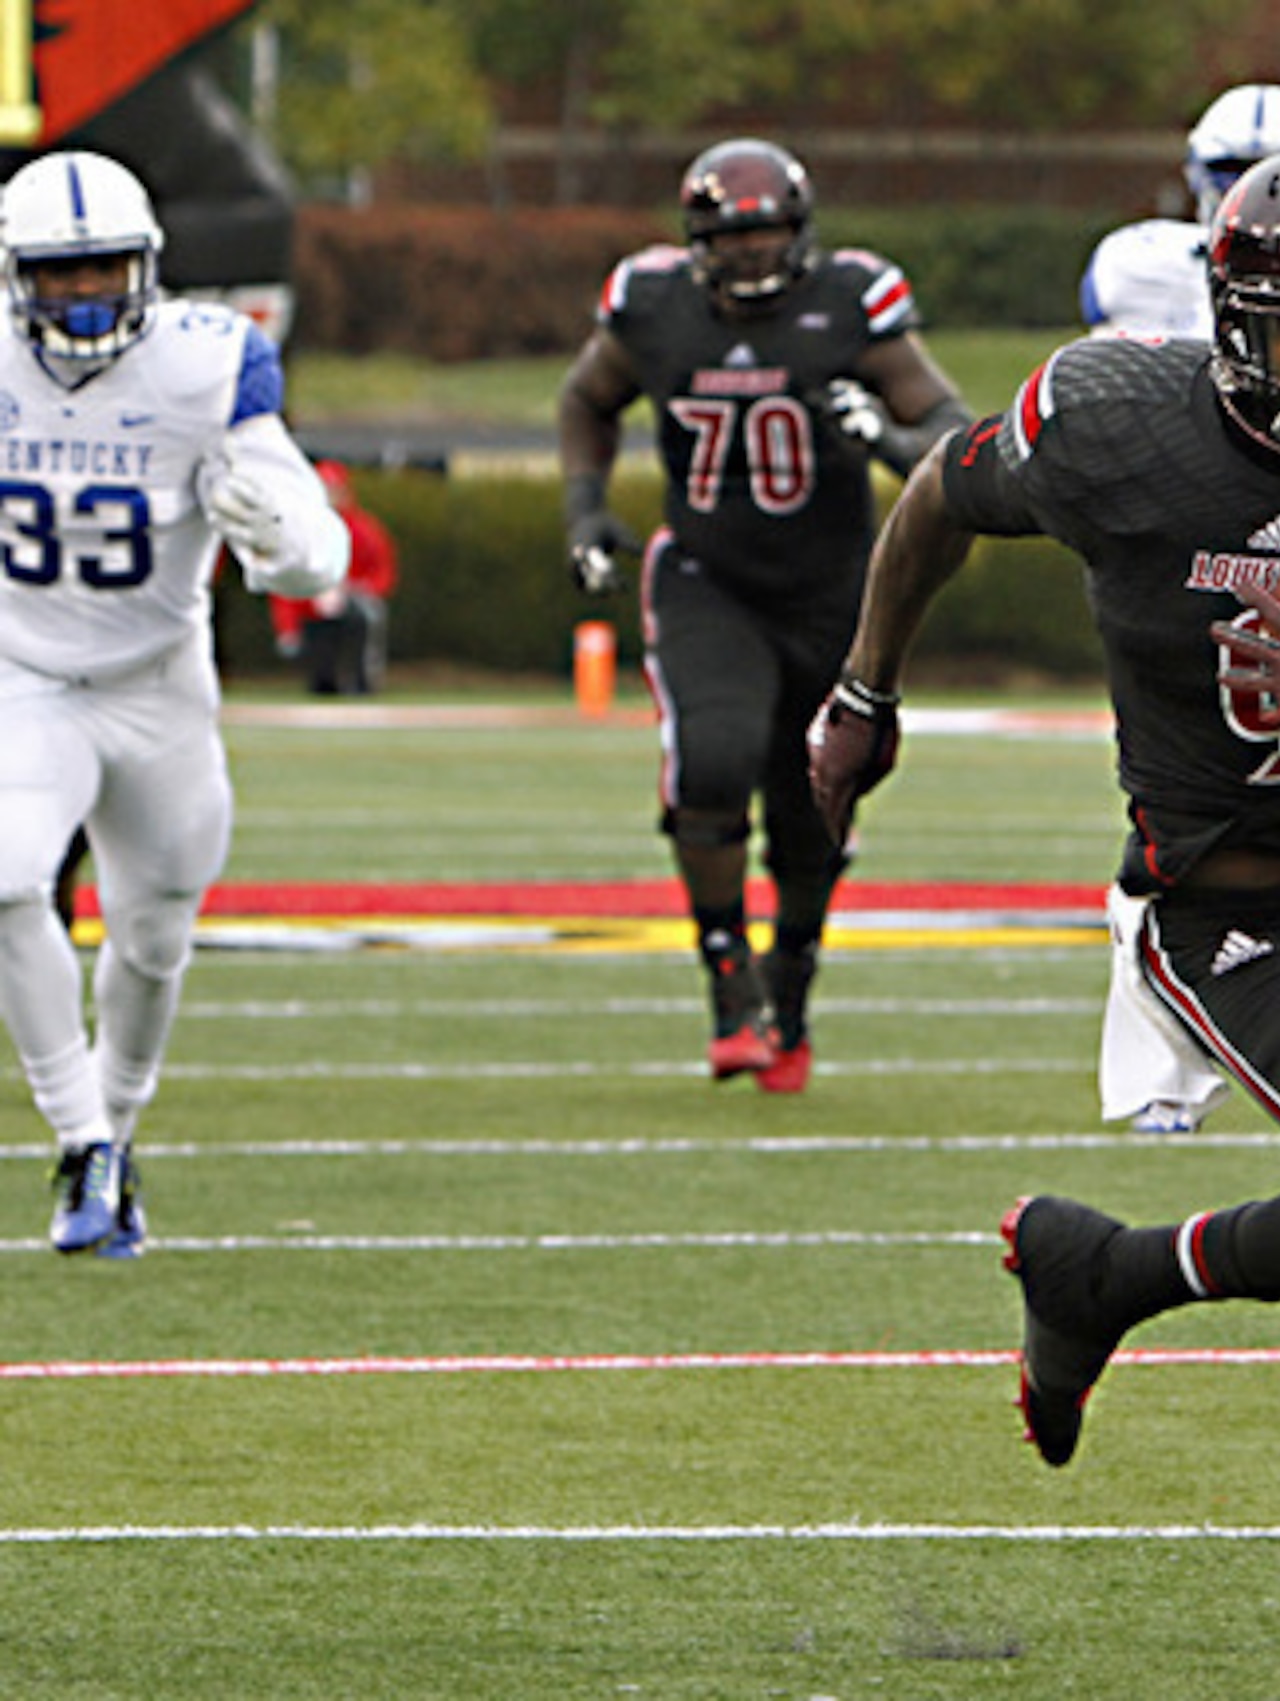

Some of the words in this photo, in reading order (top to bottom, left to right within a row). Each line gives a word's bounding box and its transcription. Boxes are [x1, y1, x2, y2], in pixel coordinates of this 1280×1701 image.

[0, 437, 153, 476] ENTUCKY
[667, 396, 814, 513] 70
[0, 479, 153, 590] 33
